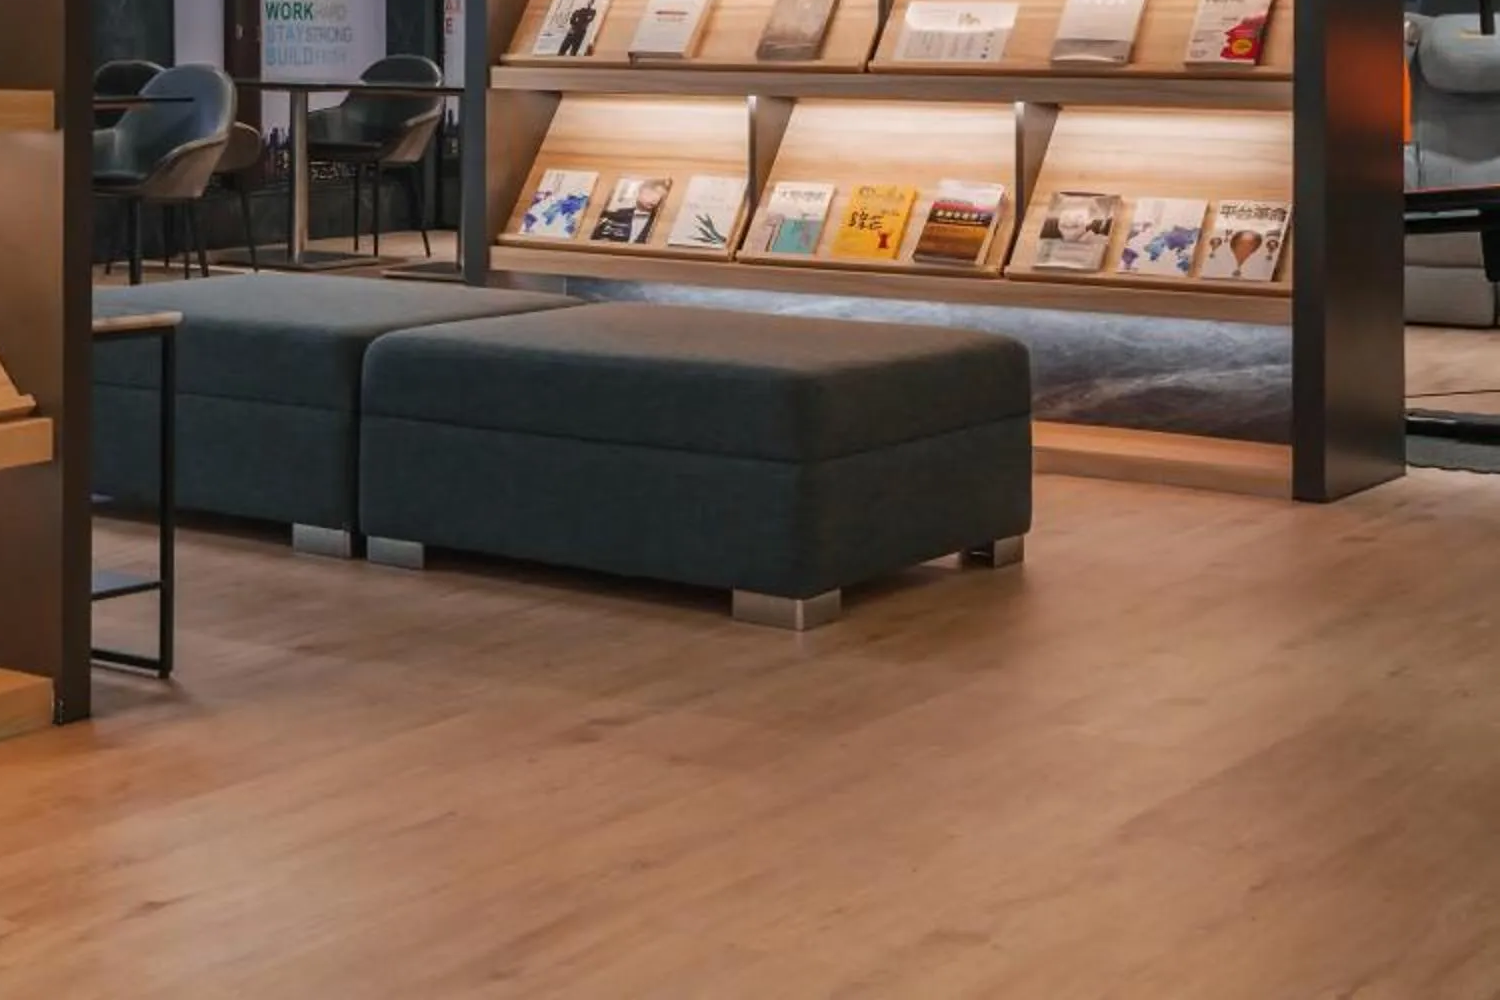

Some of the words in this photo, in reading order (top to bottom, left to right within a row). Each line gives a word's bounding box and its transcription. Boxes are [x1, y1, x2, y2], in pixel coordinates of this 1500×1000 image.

[265, 2, 314, 21] WORK
[266, 25, 305, 43] STAY
[306, 26, 353, 43] STRONG
[265, 46, 314, 66] BUILD
